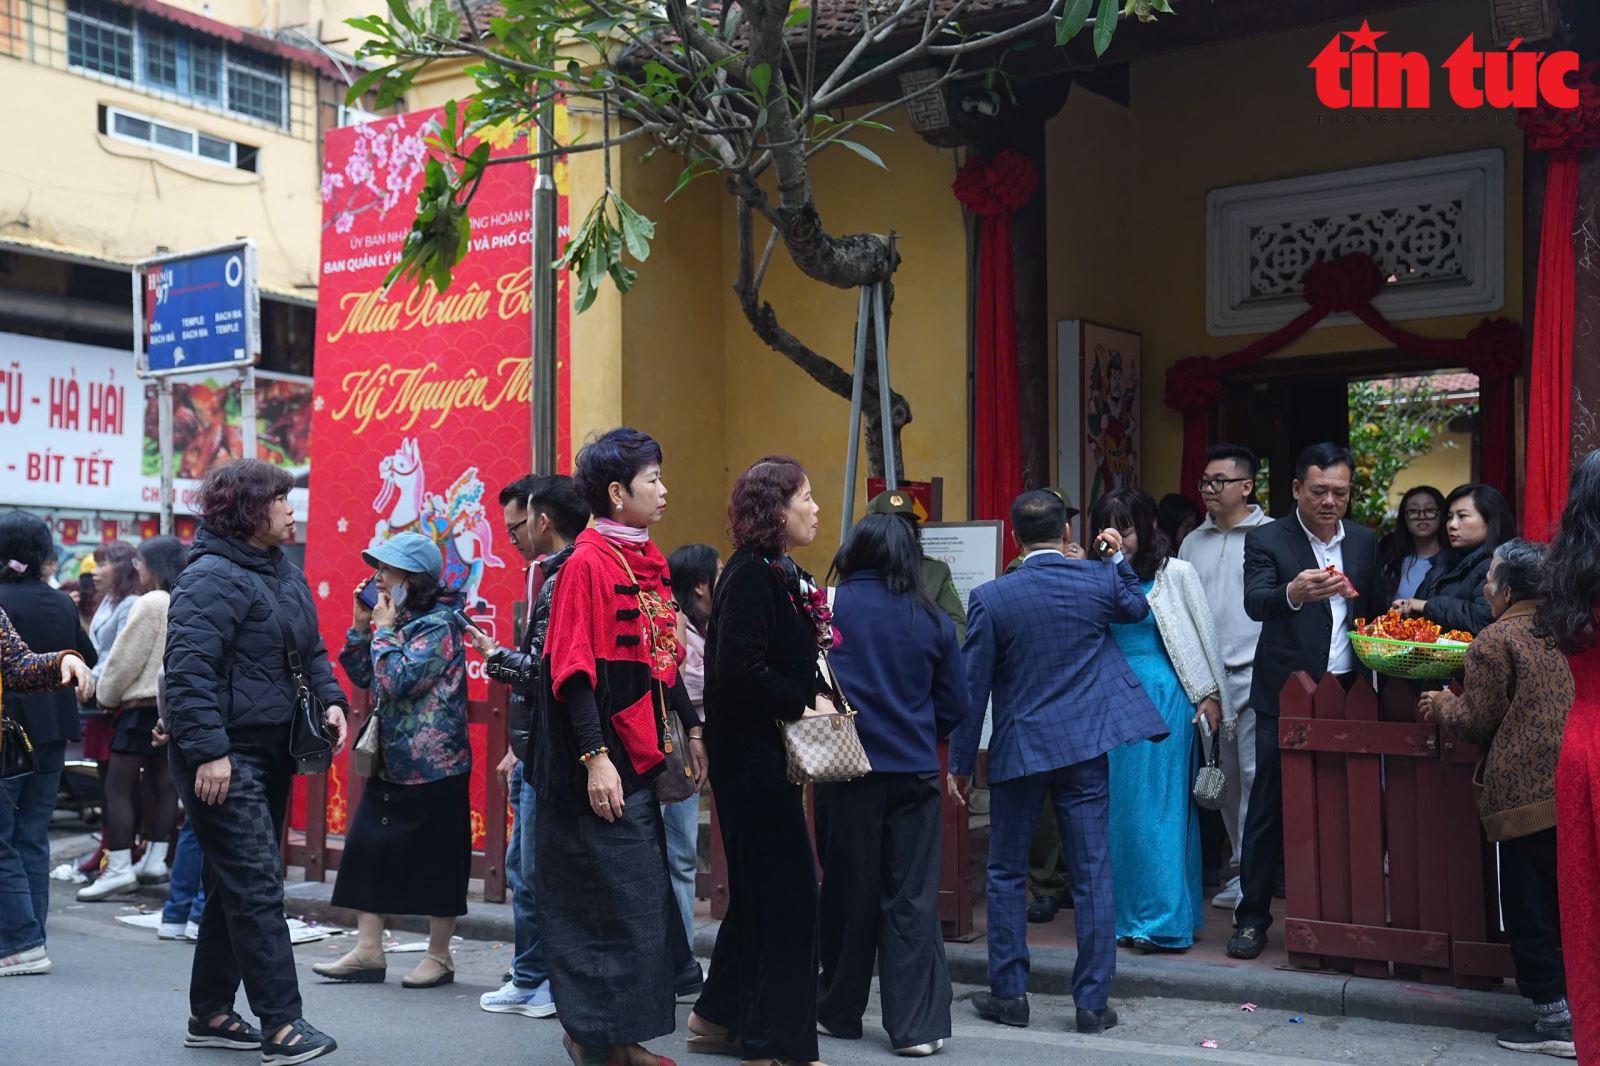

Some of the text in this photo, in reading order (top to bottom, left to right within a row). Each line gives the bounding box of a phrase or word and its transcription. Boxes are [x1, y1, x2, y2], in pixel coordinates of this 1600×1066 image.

[324, 260, 346, 274] BAN
[347, 252, 377, 272] QUẢN
[378, 250, 392, 266] LÝ
[474, 234, 490, 252] VÀ
[492, 229, 517, 248] PHỐ
[365, 234, 386, 248] BAN
[215, 322, 239, 334] TEMPLE
[49, 367, 80, 431] HÀ
[88, 367, 124, 435] HẢI
[375, 361, 489, 431] Nguyên
[27, 447, 64, 483] BÍT
[74, 448, 113, 487] TẾT
